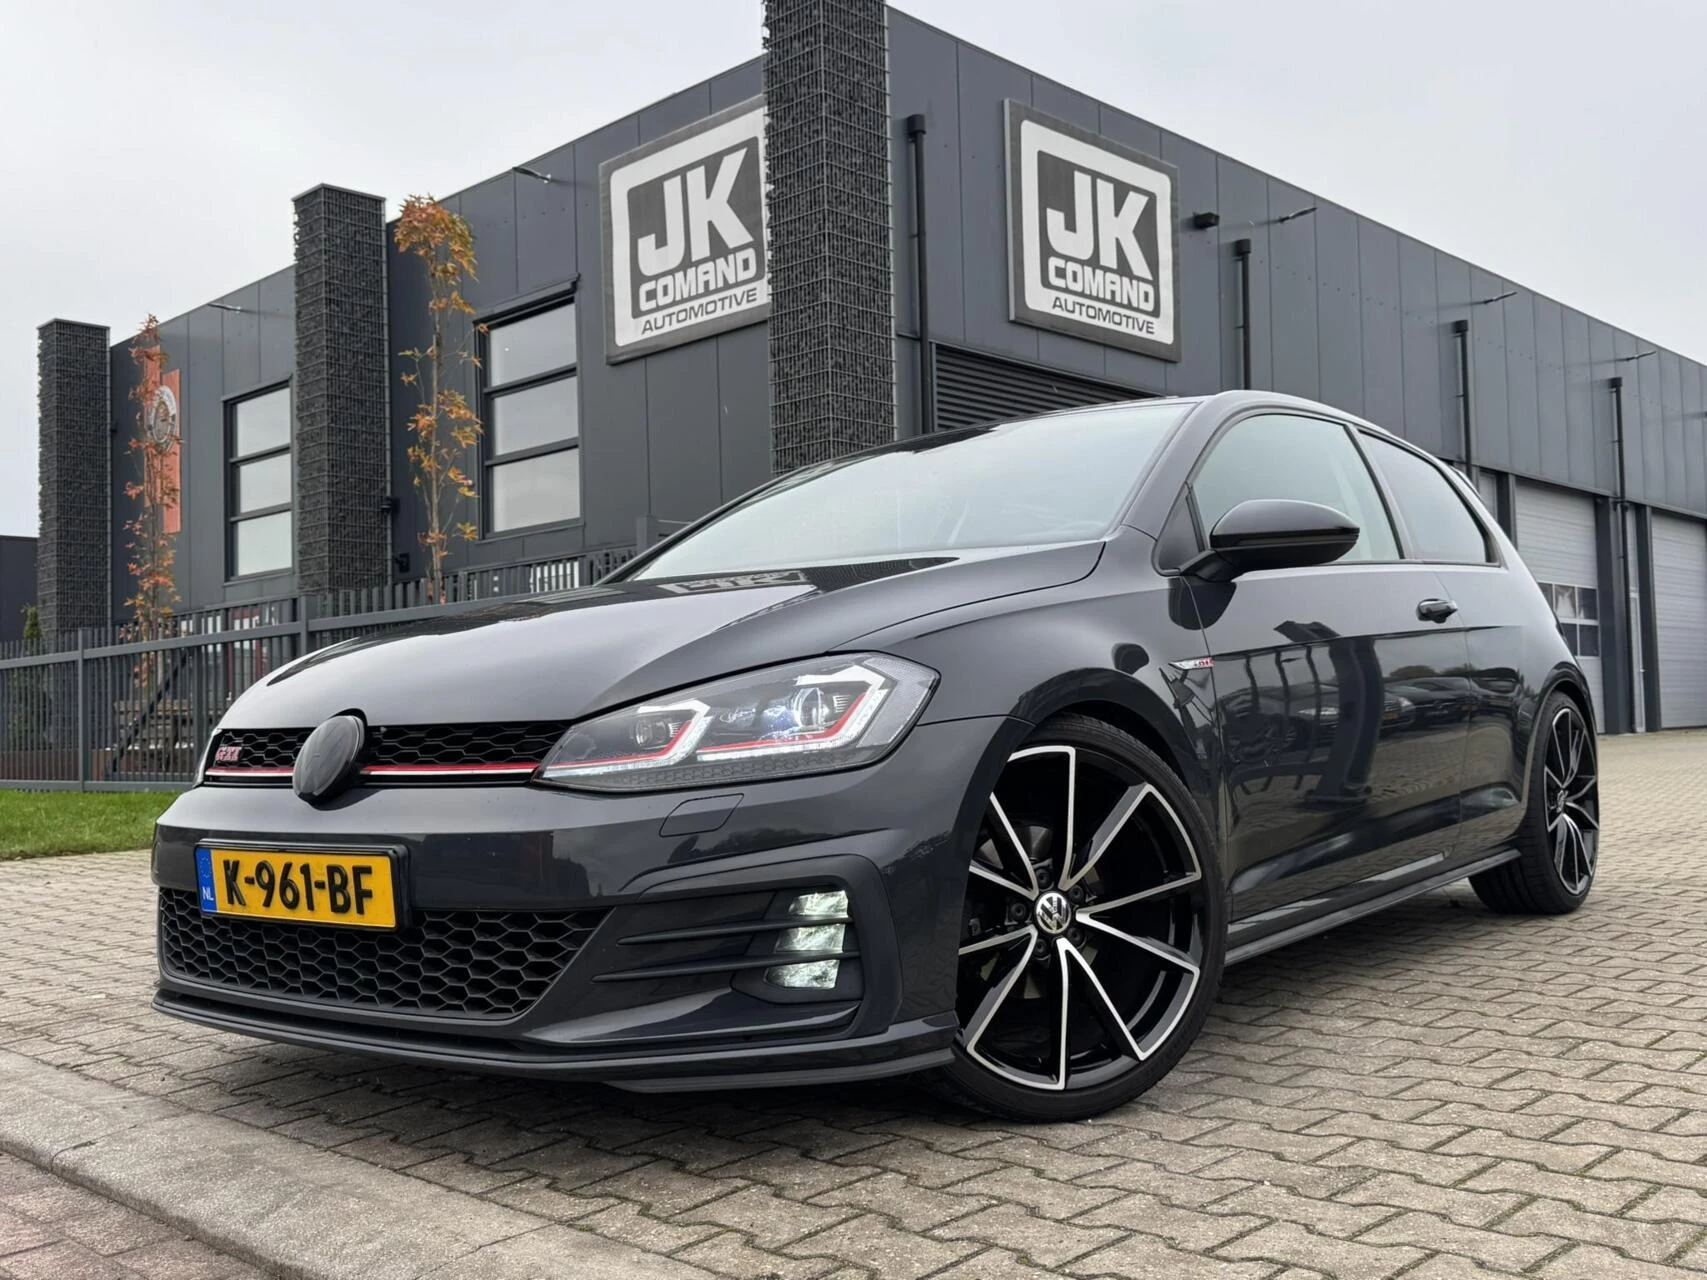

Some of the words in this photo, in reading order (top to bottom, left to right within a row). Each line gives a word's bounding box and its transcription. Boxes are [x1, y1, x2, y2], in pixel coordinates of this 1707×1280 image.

[637, 147, 754, 277] JK
[1046, 170, 1153, 281] JK
[639, 247, 757, 312] COMAND
[1048, 256, 1155, 312] COMAND
[641, 287, 758, 335] AUTOMOTIVE
[1052, 296, 1155, 335] AUTOMOTIVE
[202, 886, 214, 901] NL
[223, 860, 373, 915] K-961-BF
